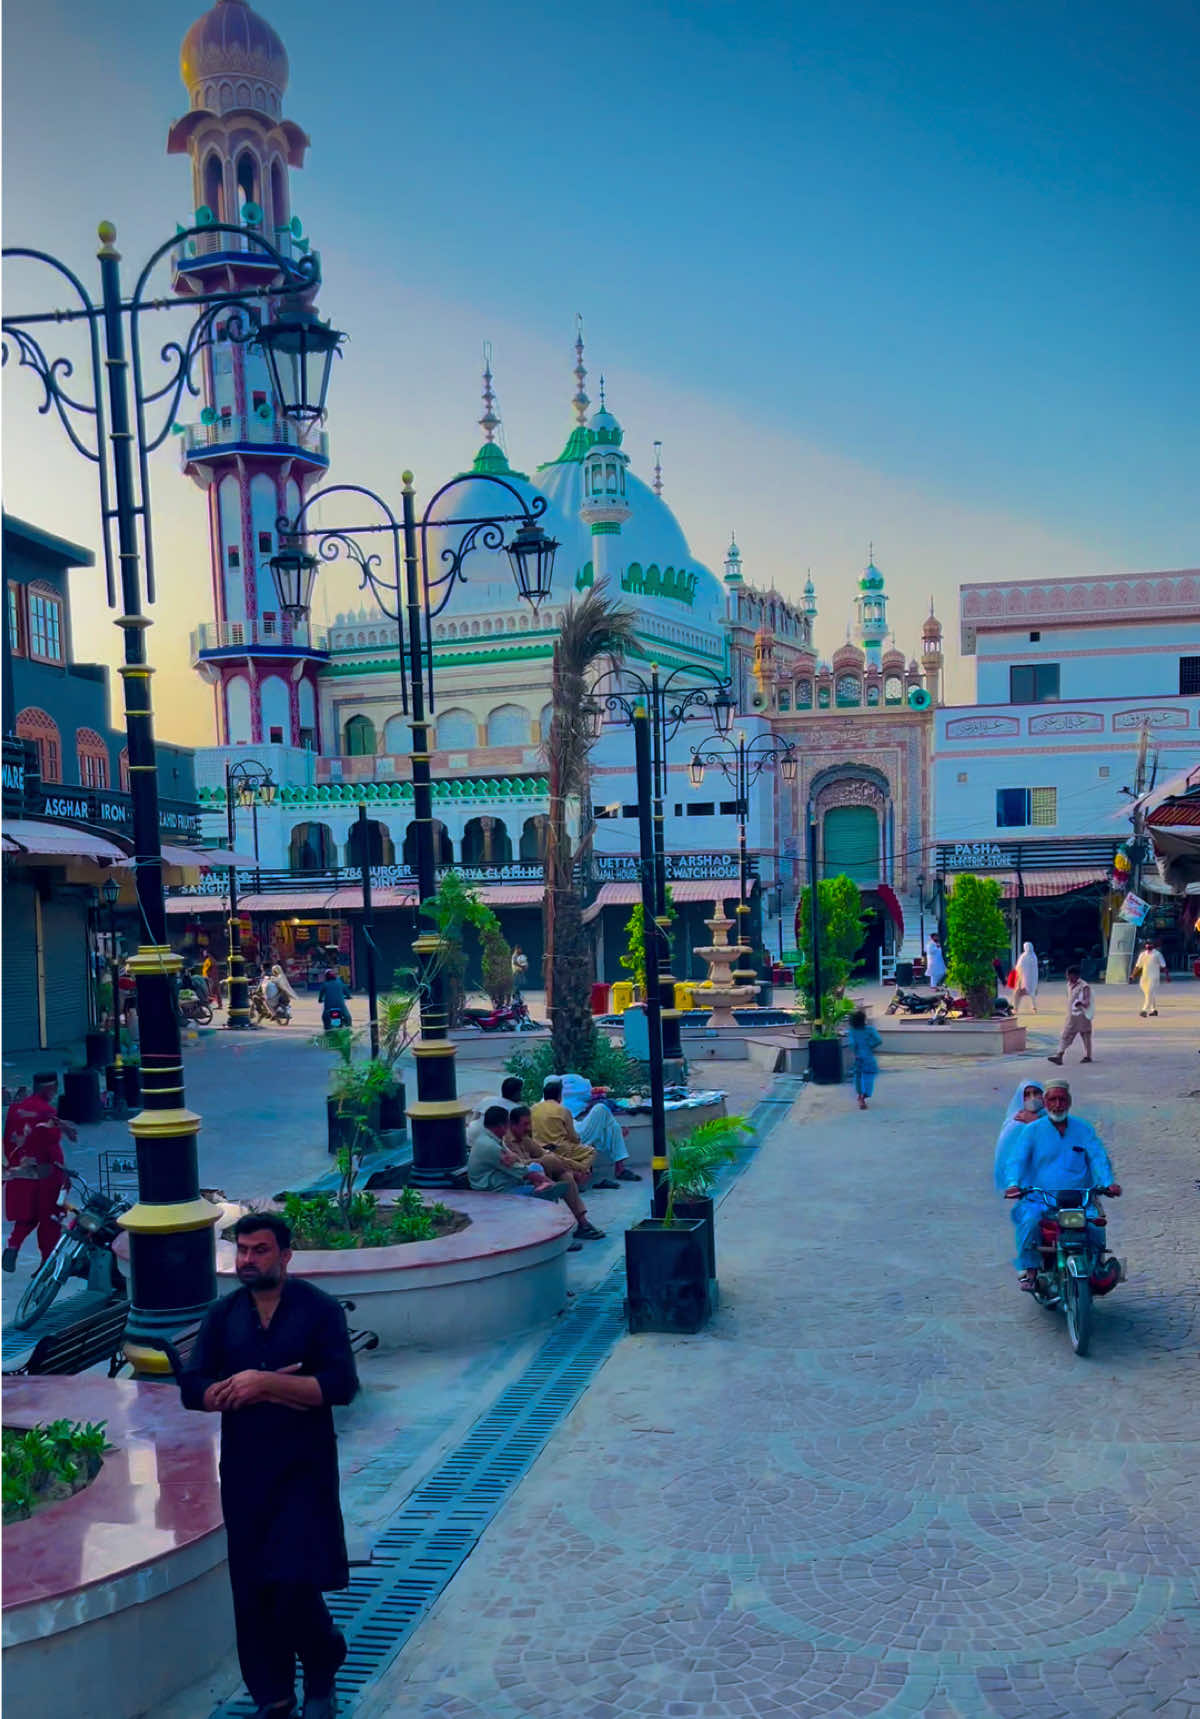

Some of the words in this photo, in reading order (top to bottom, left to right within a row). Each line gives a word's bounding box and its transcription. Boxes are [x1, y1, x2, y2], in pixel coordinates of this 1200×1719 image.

[44, 798, 89, 818] ASGHAR
[101, 803, 126, 821] IRON
[955, 843, 1001, 855] PASHA
[599, 856, 636, 869] UETTA
[680, 854, 732, 867] ARSHAD
[673, 867, 707, 879] WATCH
